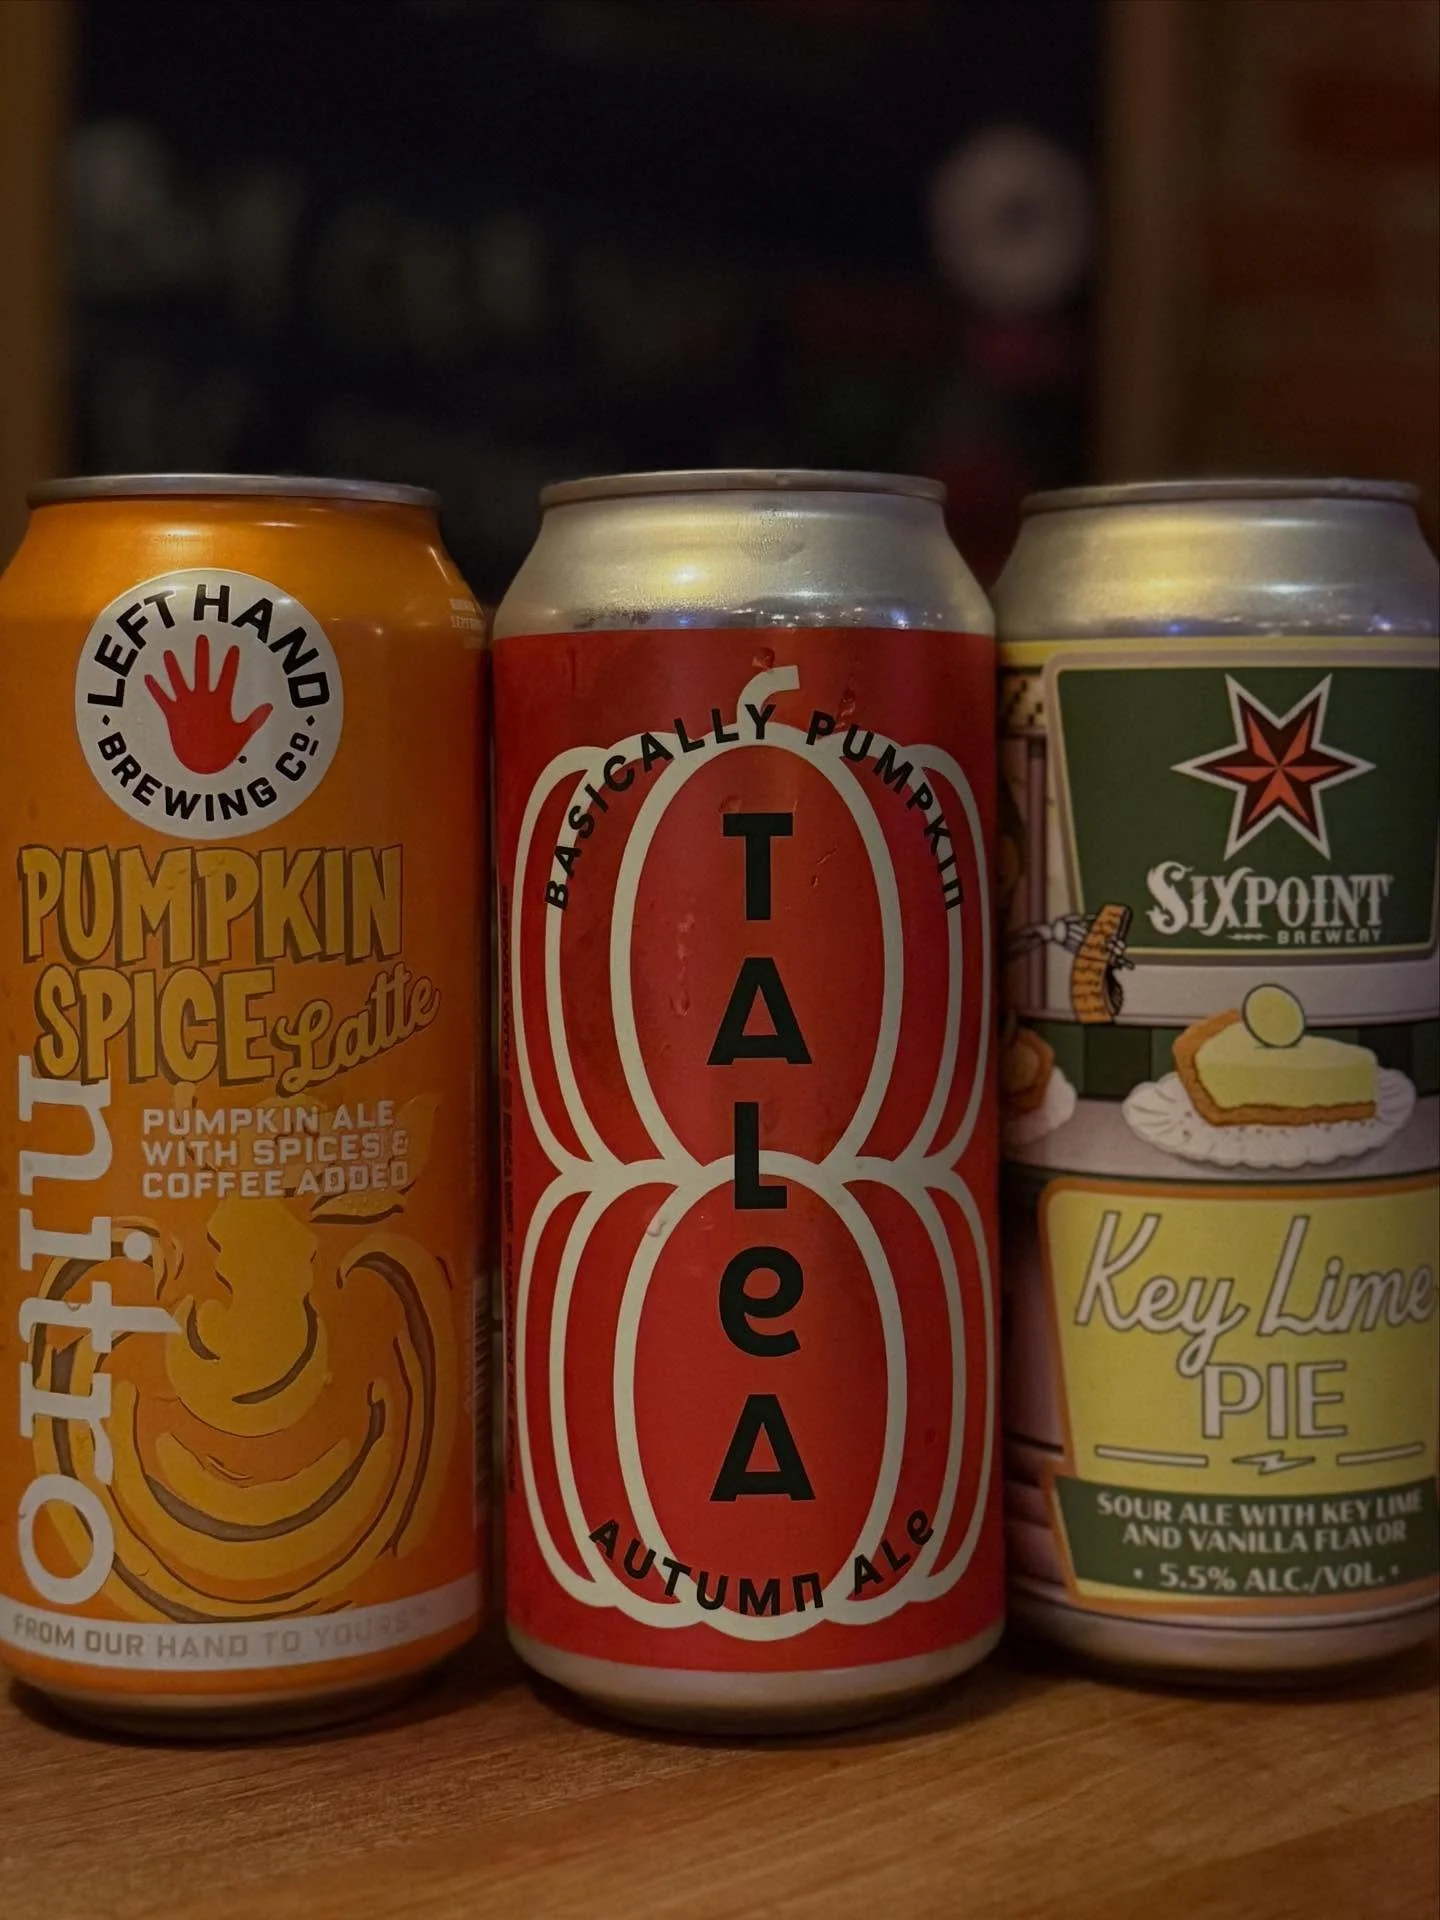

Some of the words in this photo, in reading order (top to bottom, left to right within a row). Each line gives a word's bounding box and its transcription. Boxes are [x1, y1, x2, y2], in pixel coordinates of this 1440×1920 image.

[87, 590, 177, 708] LEFT
[193, 584, 331, 708] HAND
[98, 731, 277, 822] BREWING
[544, 704, 776, 911] BASICALLY
[18, 844, 403, 967] PUMPKIN
[1145, 860, 1394, 936] SIXPOINT
[1276, 928, 1382, 945] BREWERY
[34, 963, 276, 1086] SPICE
[271, 961, 441, 1098] Latte
[141, 1138, 238, 1168] WITH
[253, 1132, 383, 1166] SPICES
[142, 1106, 321, 1137] PUMPKIN
[332, 1100, 395, 1130] ALE
[142, 1170, 284, 1199] COFFEE
[296, 1160, 409, 1196] ADDED
[1074, 1211, 1250, 1378] Key
[1257, 1214, 1432, 1337] Lime
[1201, 1361, 1348, 1440] PIE
[1096, 1492, 1173, 1523] SOUR
[1178, 1501, 1233, 1527] ALE
[1239, 1503, 1315, 1528] WITH
[1321, 1499, 1373, 1526] KEY
[1375, 1488, 1423, 1519] LIME
[1121, 1522, 1182, 1550] AND
[1187, 1530, 1308, 1555] VANILLA
[1314, 1519, 1407, 1551] FLAVOR
[1159, 1562, 1238, 1593] 5.5%
[12, 1612, 76, 1650] FROM
[85, 1628, 144, 1657] OUR
[156, 1634, 250, 1659] HAND
[263, 1629, 300, 1655] TO
